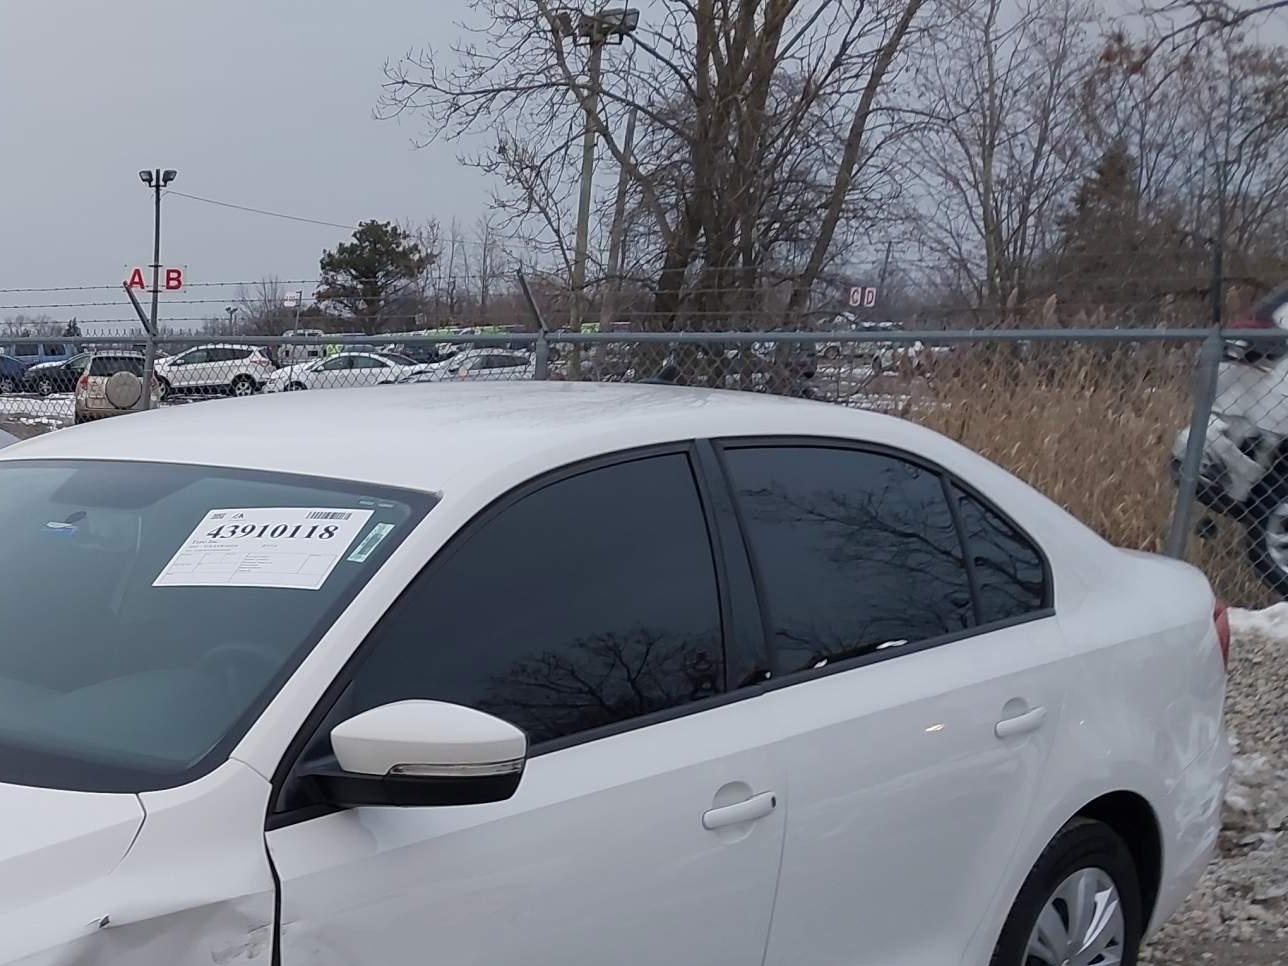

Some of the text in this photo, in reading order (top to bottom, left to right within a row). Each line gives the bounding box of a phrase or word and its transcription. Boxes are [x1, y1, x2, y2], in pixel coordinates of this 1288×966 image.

[128, 268, 182, 290] A B
[206, 523, 339, 540] 43910118
